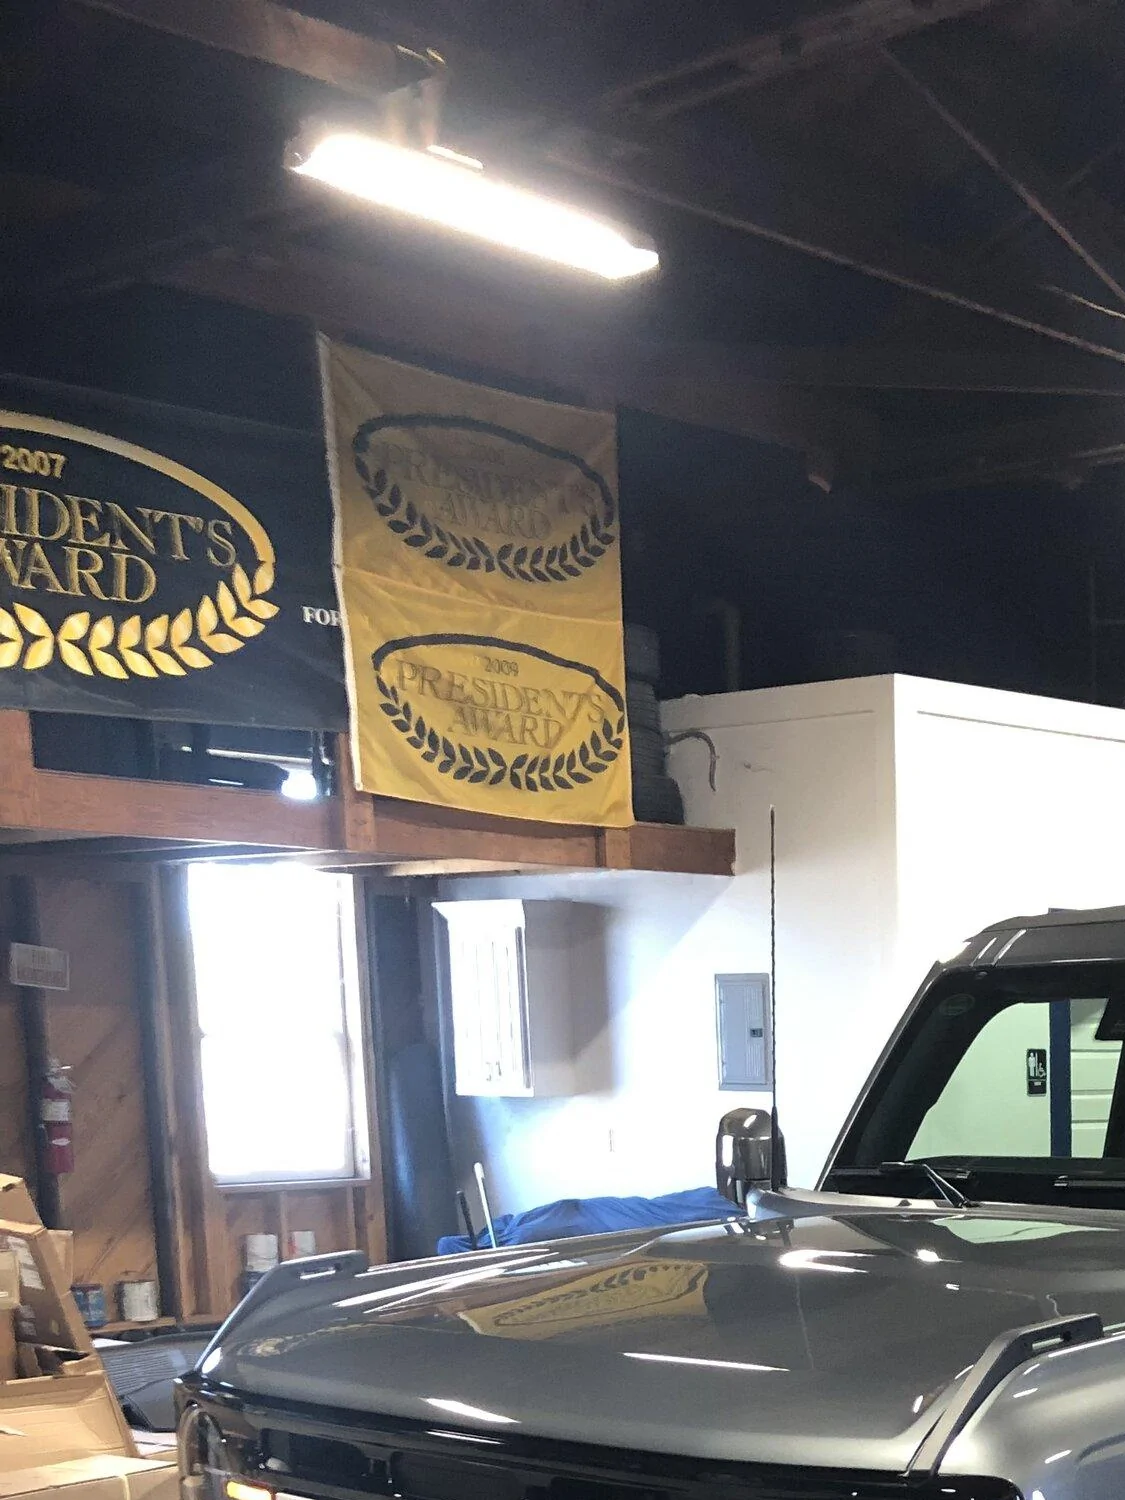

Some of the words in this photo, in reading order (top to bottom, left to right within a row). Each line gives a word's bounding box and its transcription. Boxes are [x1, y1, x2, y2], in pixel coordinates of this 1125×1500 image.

[1, 443, 67, 480] 2007
[396, 659, 605, 724] PRESIDENT'S
[447, 704, 563, 749] AWARD
